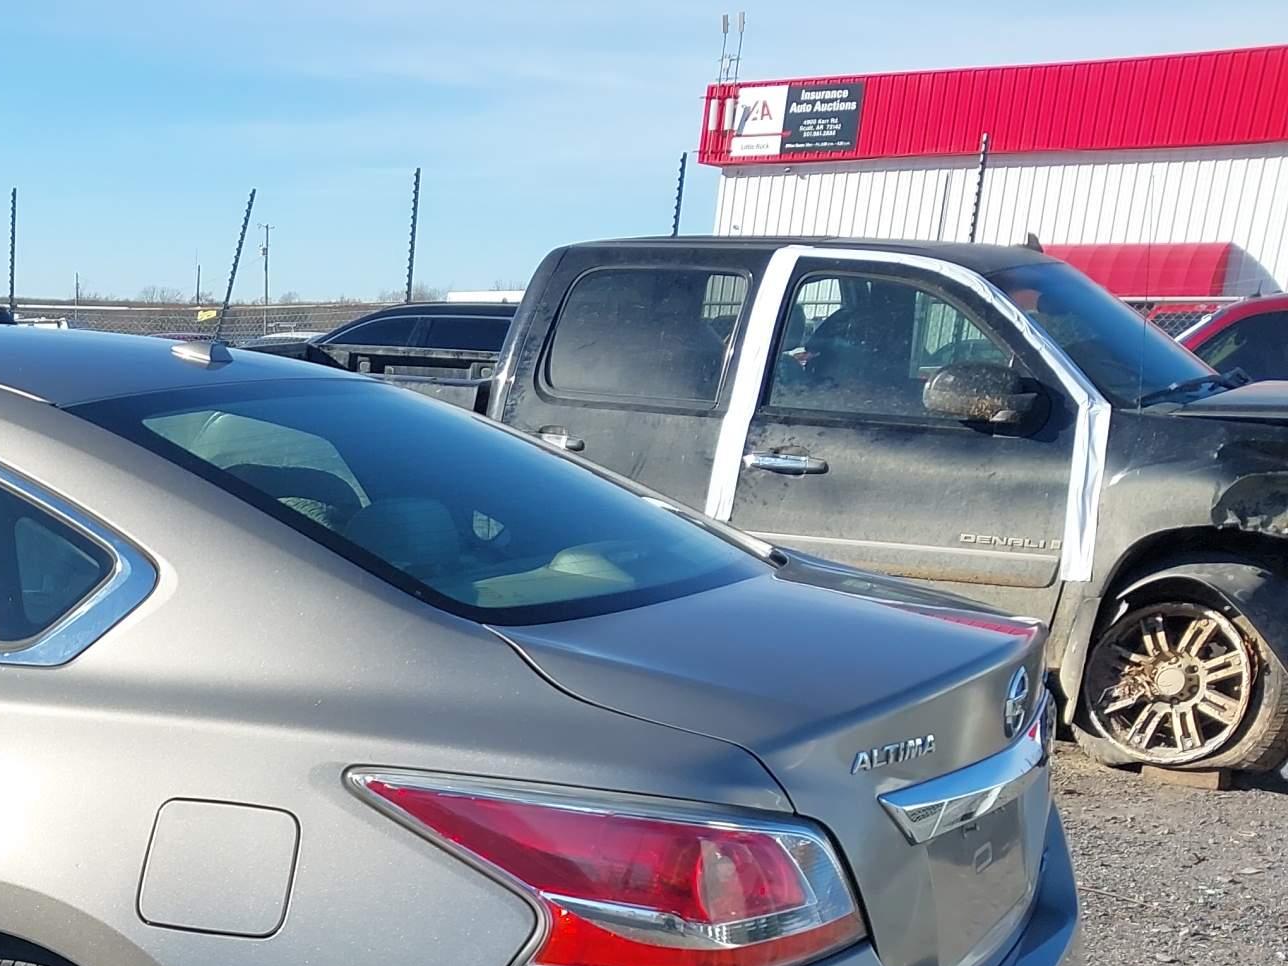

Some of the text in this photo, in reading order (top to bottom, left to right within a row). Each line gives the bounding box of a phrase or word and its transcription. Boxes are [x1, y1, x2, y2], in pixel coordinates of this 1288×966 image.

[801, 89, 848, 100] Insurance
[789, 99, 857, 113] Auto Auctions
[959, 532, 1046, 549] DENALI
[850, 733, 936, 775] ALTIMA
